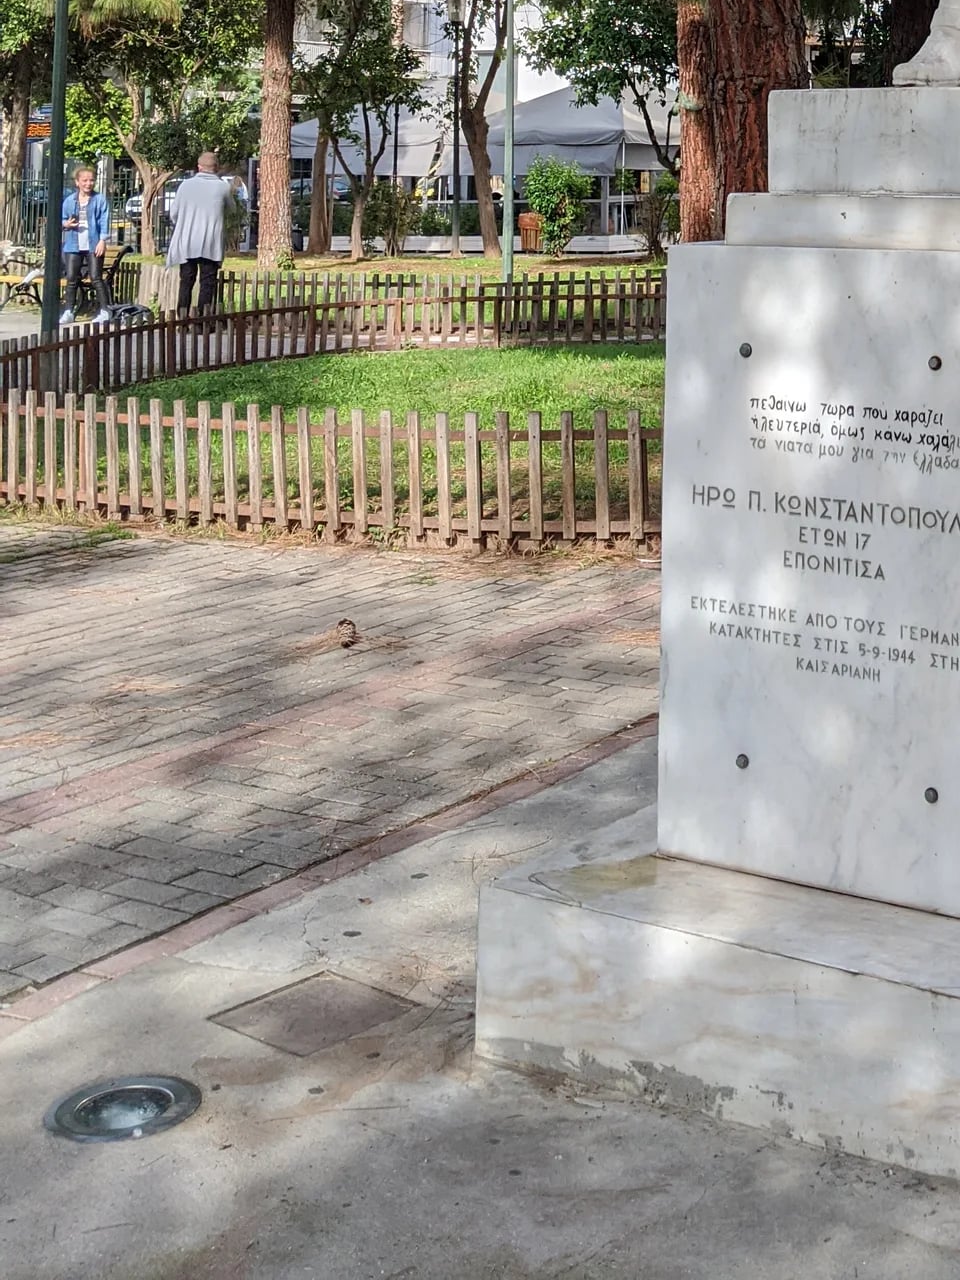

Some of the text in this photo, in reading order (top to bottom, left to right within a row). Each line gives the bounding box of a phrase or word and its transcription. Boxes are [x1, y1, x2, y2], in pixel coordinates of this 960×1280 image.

[818, 444, 844, 459] μου
[748, 490, 767, 512] Π.
[799, 526, 871, 550] ΕΤΩΝ 17
[783, 550, 885, 581] ΕΠΟΝΙΤΙΣΑ
[691, 596, 797, 623] ΕΚΤΕΛΕΣΤΗΚΕ
[805, 612, 838, 629] ΑΠΟ
[844, 617, 886, 636] ΤΟΥΣ
[709, 621, 802, 648] ΚΑΤΑΚΤΗΤΕΣ
[813, 637, 849, 654] ΣΤΙΣ
[858, 643, 916, 664] 5-9-1944
[796, 656, 881, 683] ΚΑΙΣΑΡΙΑΝΗ
